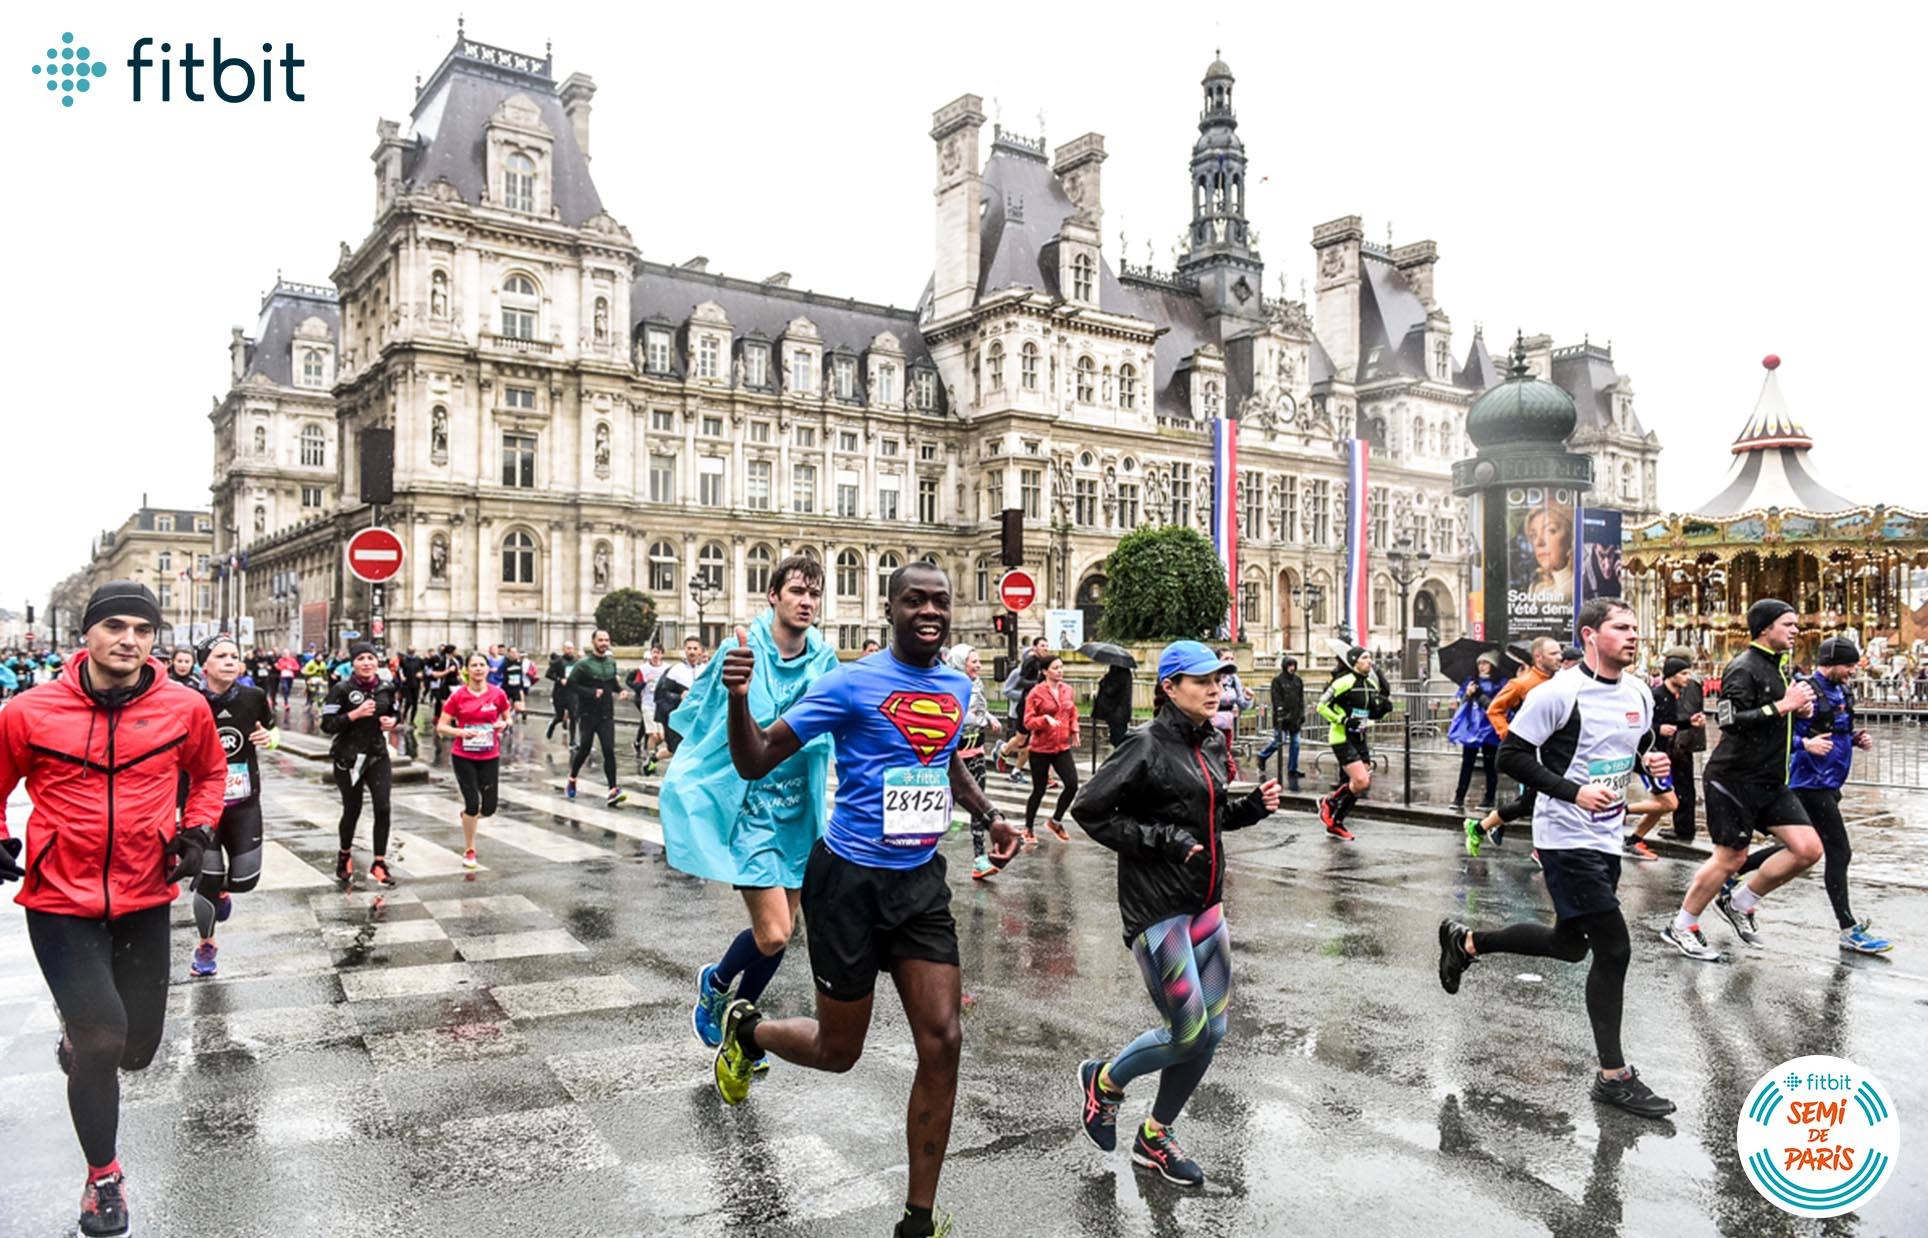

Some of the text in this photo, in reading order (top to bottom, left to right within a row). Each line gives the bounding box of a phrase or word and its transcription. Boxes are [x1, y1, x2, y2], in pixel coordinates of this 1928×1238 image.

[1507, 589, 1564, 603] Soudain
[1507, 602, 1538, 615] l'été
[886, 790, 944, 812] 28152
